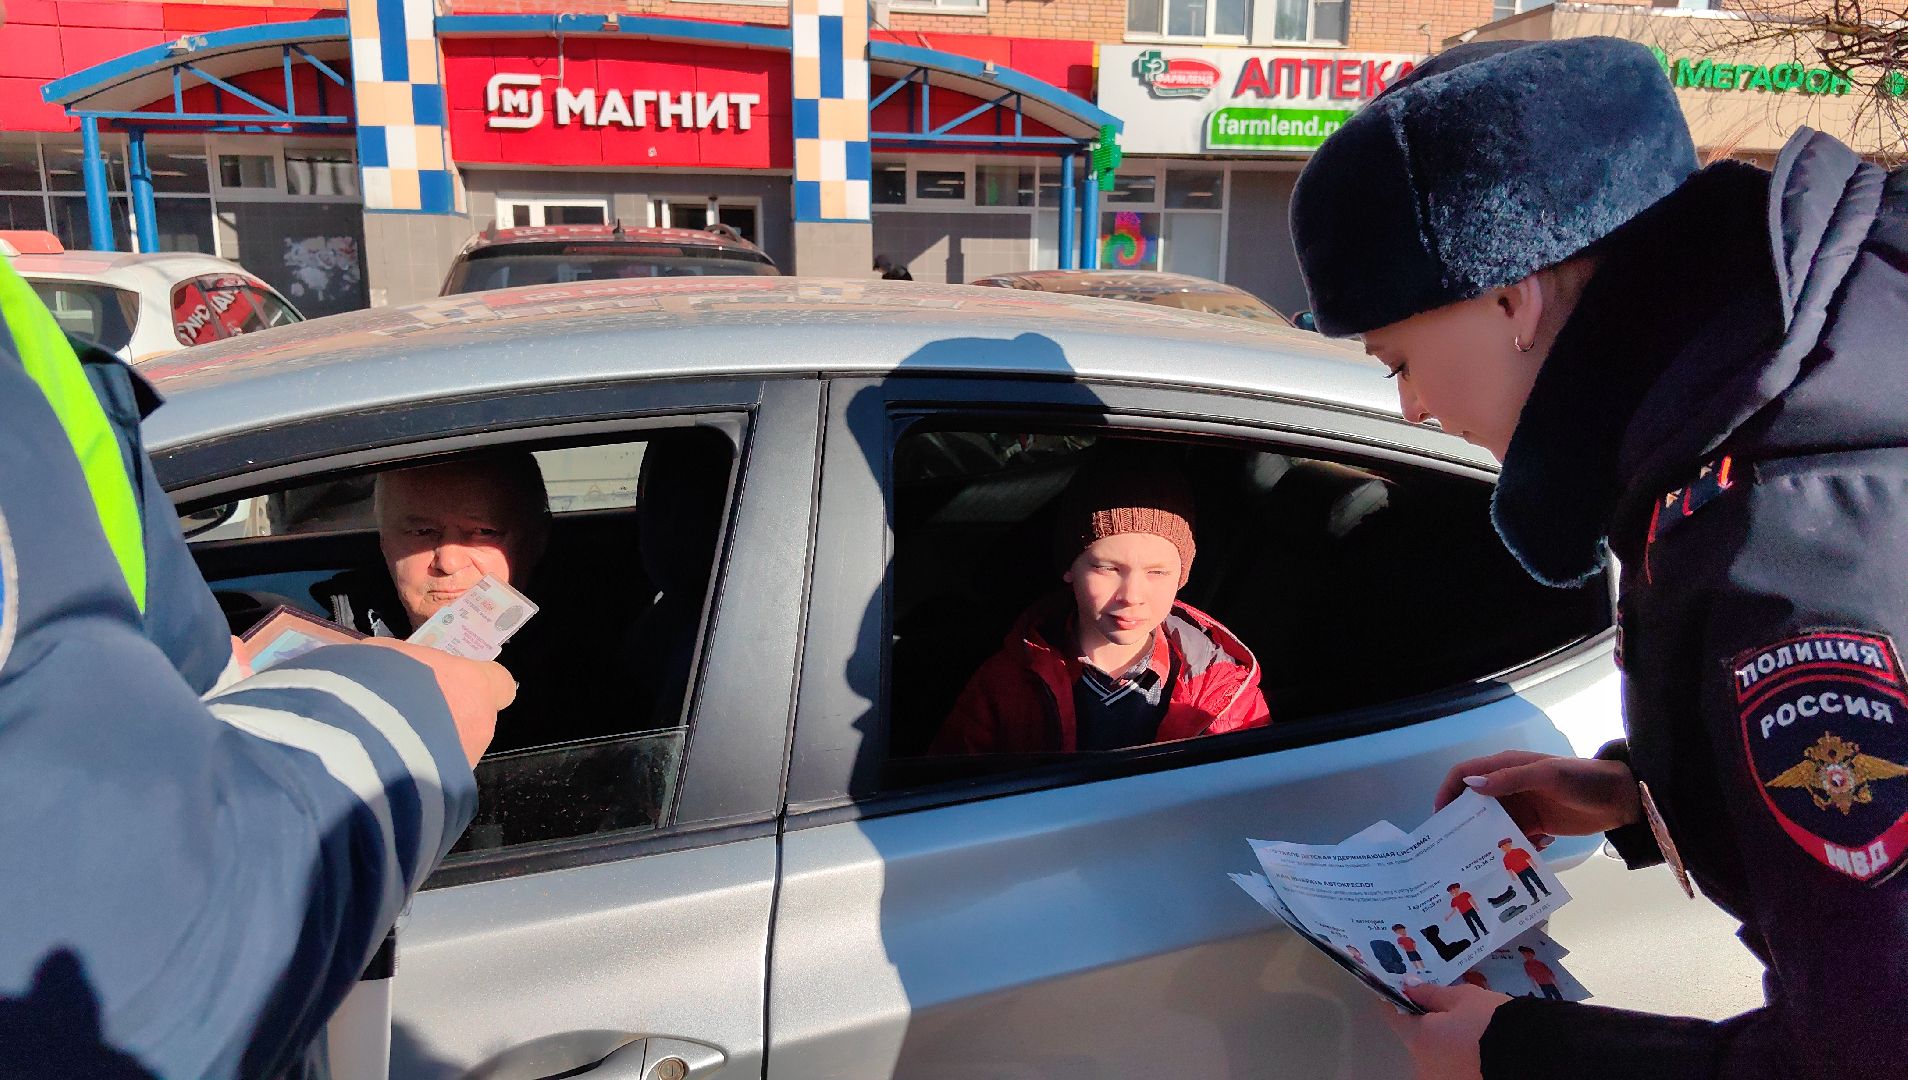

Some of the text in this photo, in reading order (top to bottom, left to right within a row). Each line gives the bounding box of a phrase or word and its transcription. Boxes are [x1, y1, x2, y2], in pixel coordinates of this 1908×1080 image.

[555, 87, 760, 130] МАГНИТ
[1743, 640, 1883, 687] ПОЛИЦИЯ
[1760, 692, 1893, 738] РОССИЯ
[1333, 851, 1396, 862] УДЕРЖИВАЮЩАЯ
[1396, 834, 1431, 858] СИСТЕМА?
[1823, 841, 1889, 877] МВД
